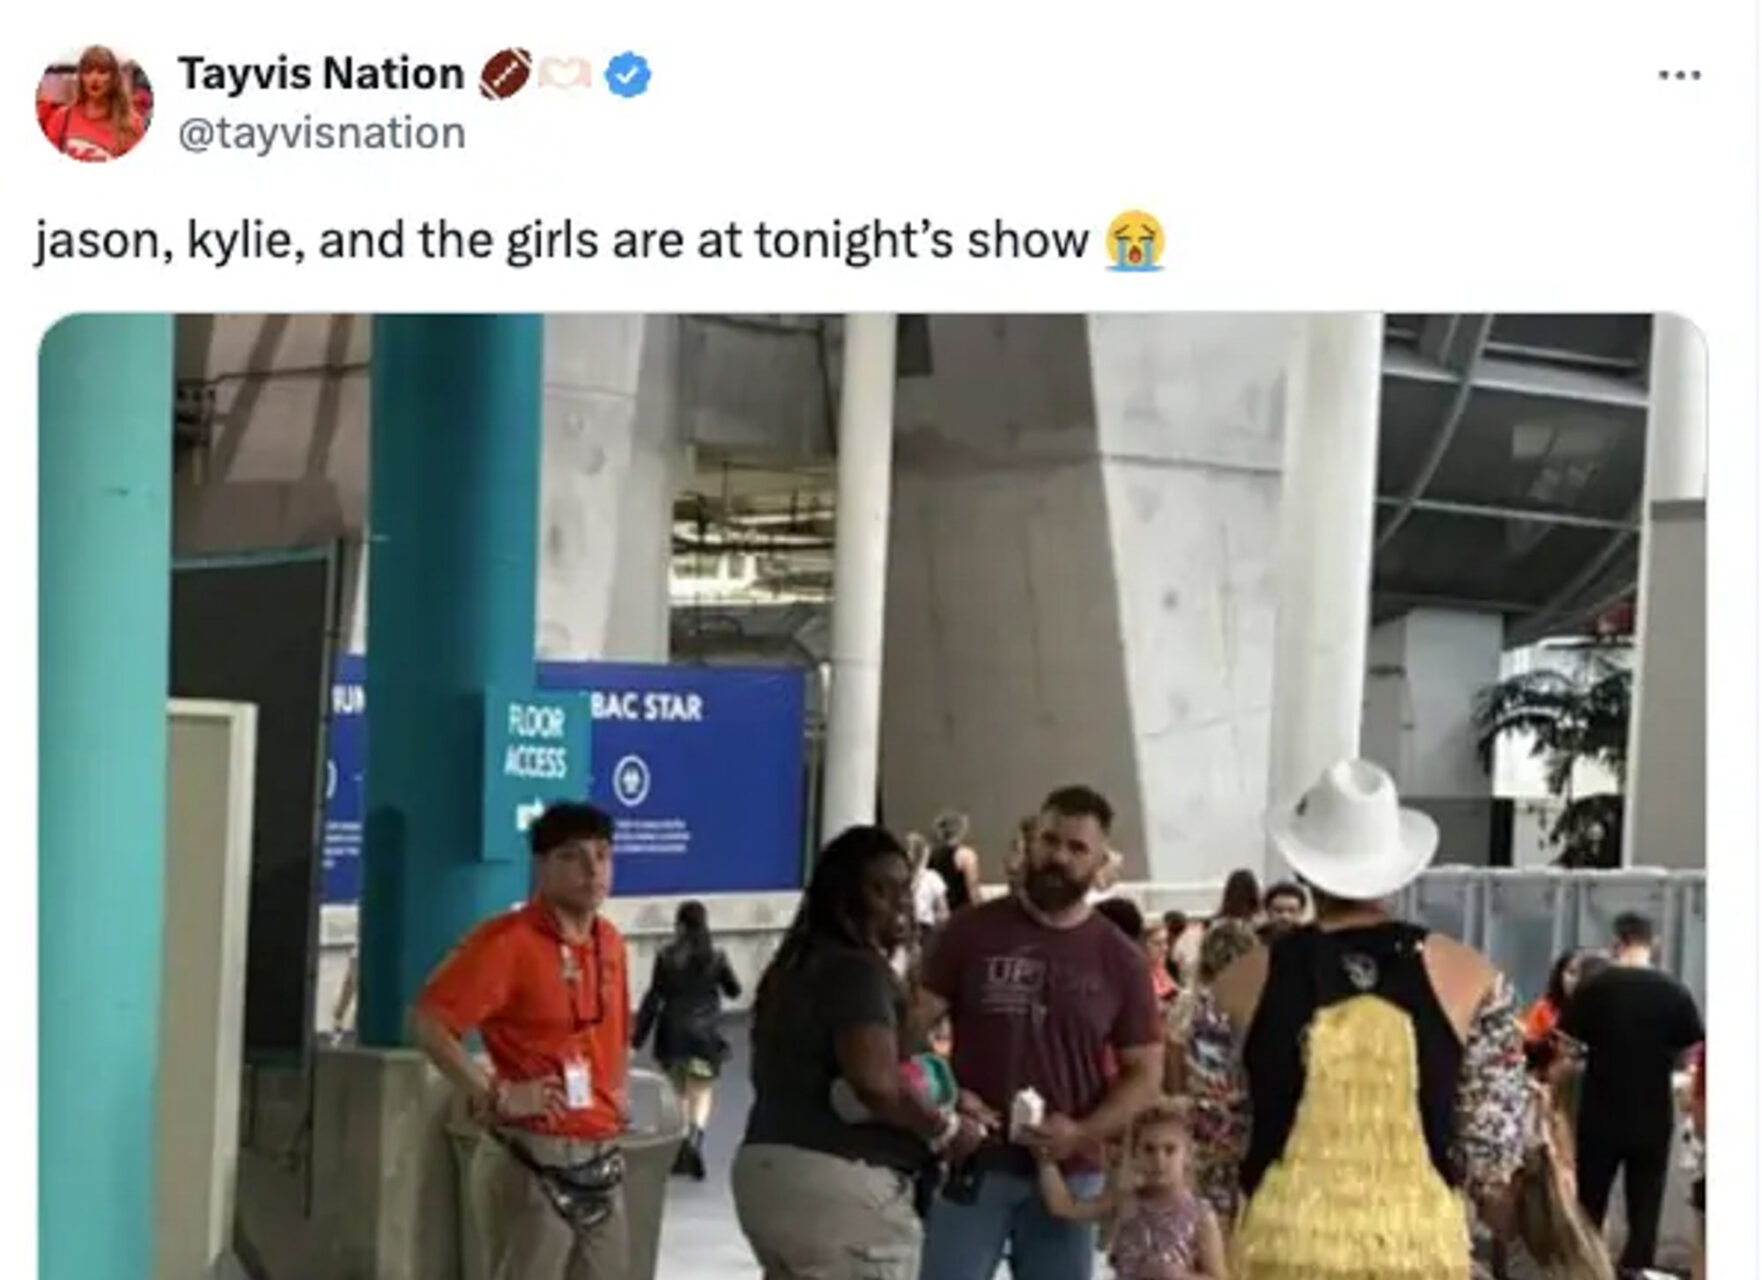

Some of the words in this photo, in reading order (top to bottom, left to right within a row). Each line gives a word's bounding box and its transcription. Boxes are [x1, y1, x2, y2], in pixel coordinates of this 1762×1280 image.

[507, 702, 567, 738] FLOOR
[643, 691, 703, 722] STAR
[503, 744, 568, 779] ACCESS
